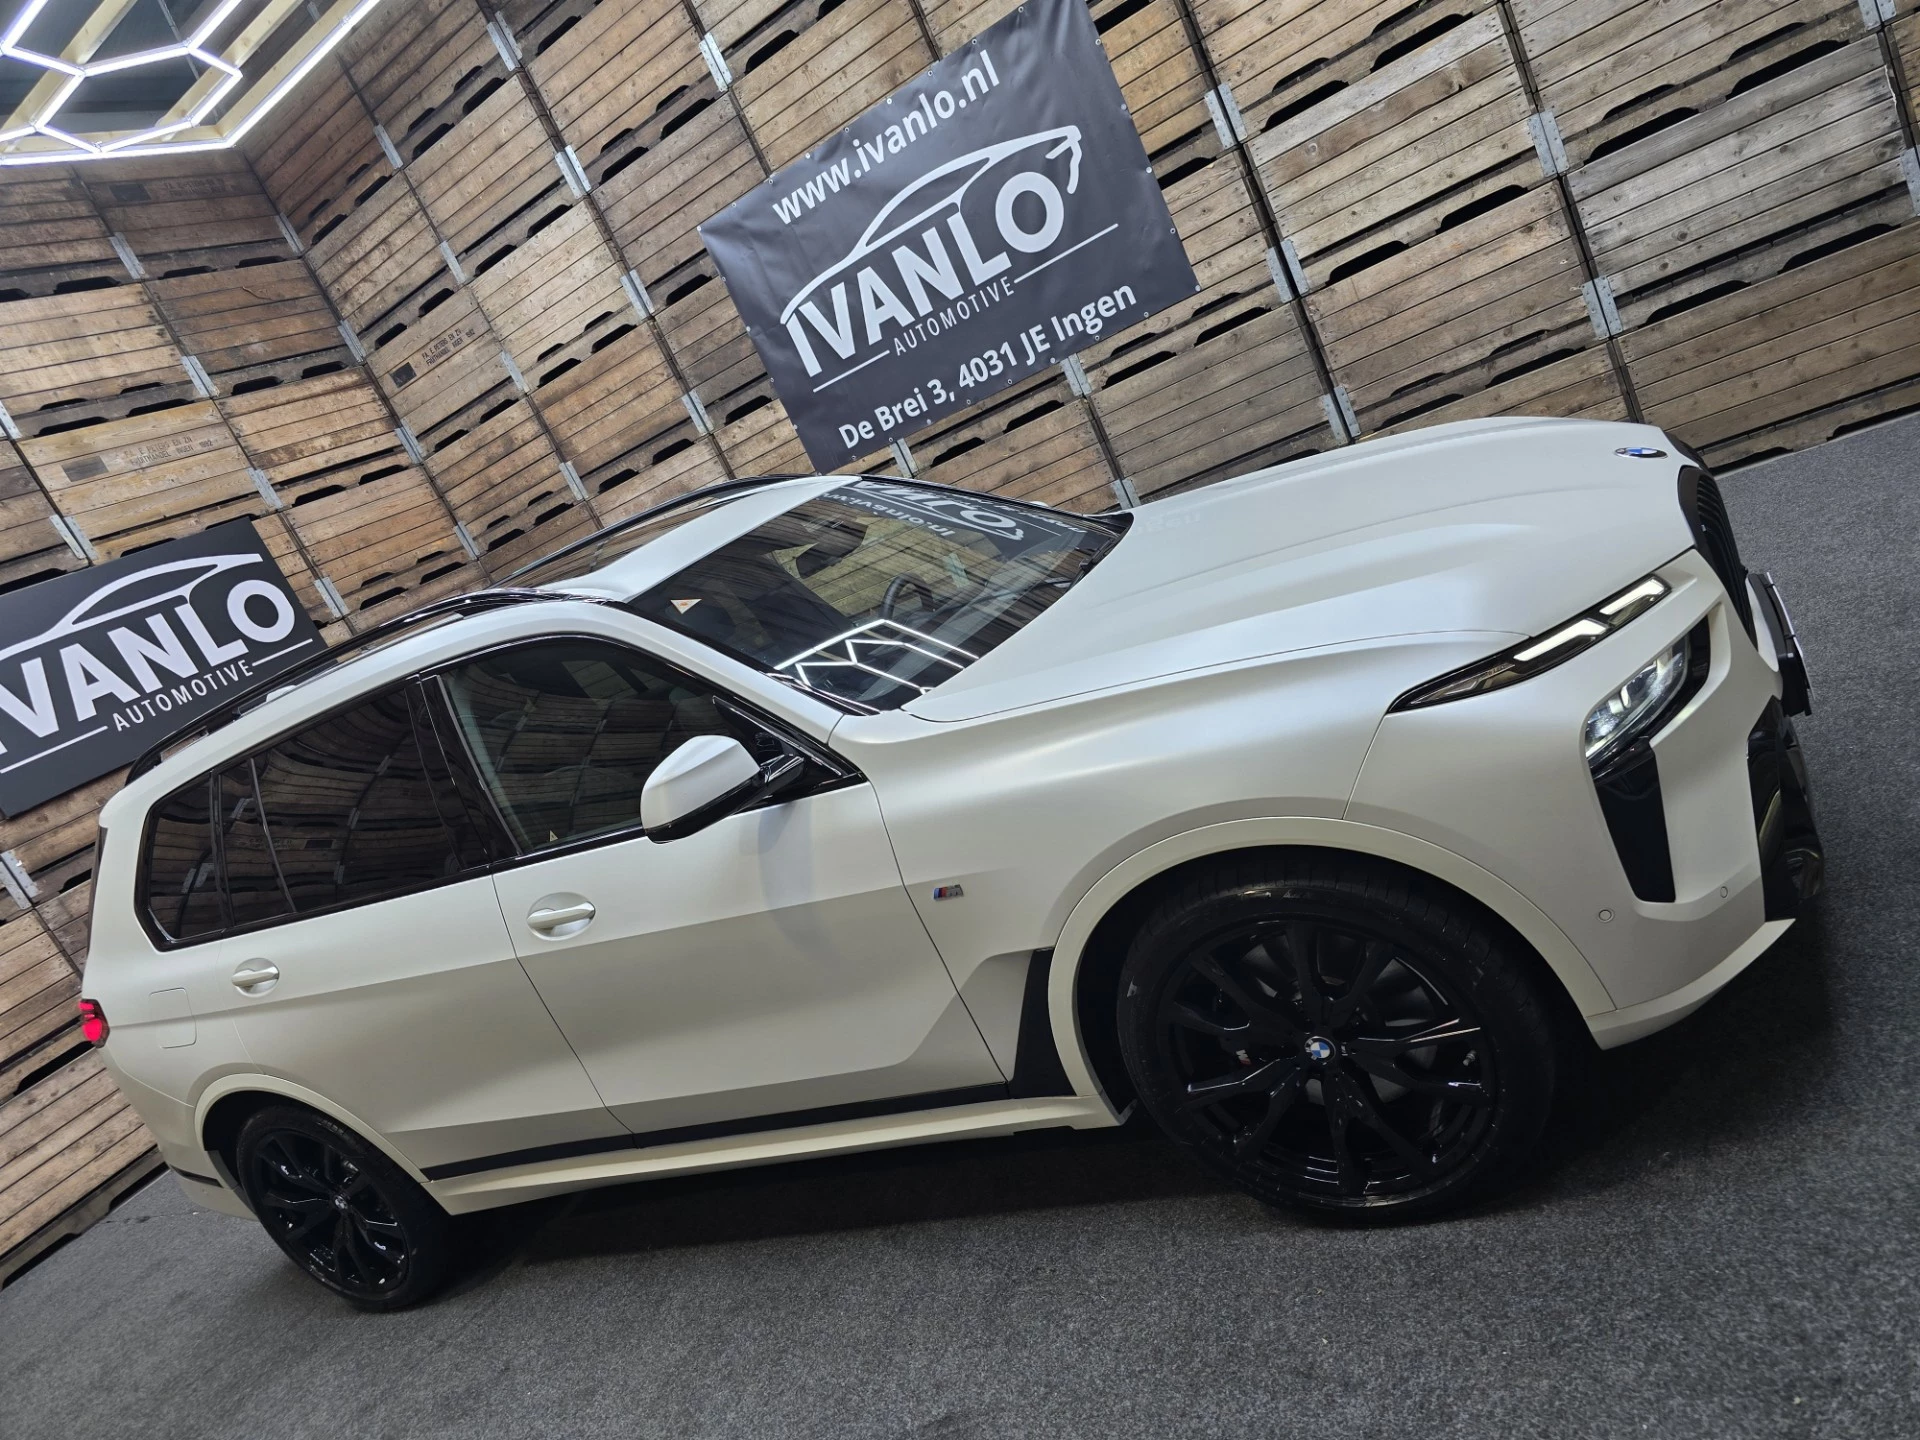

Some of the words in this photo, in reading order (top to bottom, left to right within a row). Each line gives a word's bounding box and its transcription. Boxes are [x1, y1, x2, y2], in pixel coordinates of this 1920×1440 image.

[772, 49, 1000, 225] www.ivanlo.nl
[784, 171, 1064, 378] IVANLO
[893, 276, 1015, 356] AUTOMOTIVE
[838, 420, 875, 449] De
[875, 387, 928, 432] Brei
[926, 378, 955, 406] 3,
[958, 341, 1018, 388] 4031
[1019, 324, 1051, 366] JE
[1050, 285, 1137, 342] Ingen
[0, 579, 295, 755] VANLO
[112, 659, 254, 732] AUTOMOTIVE
